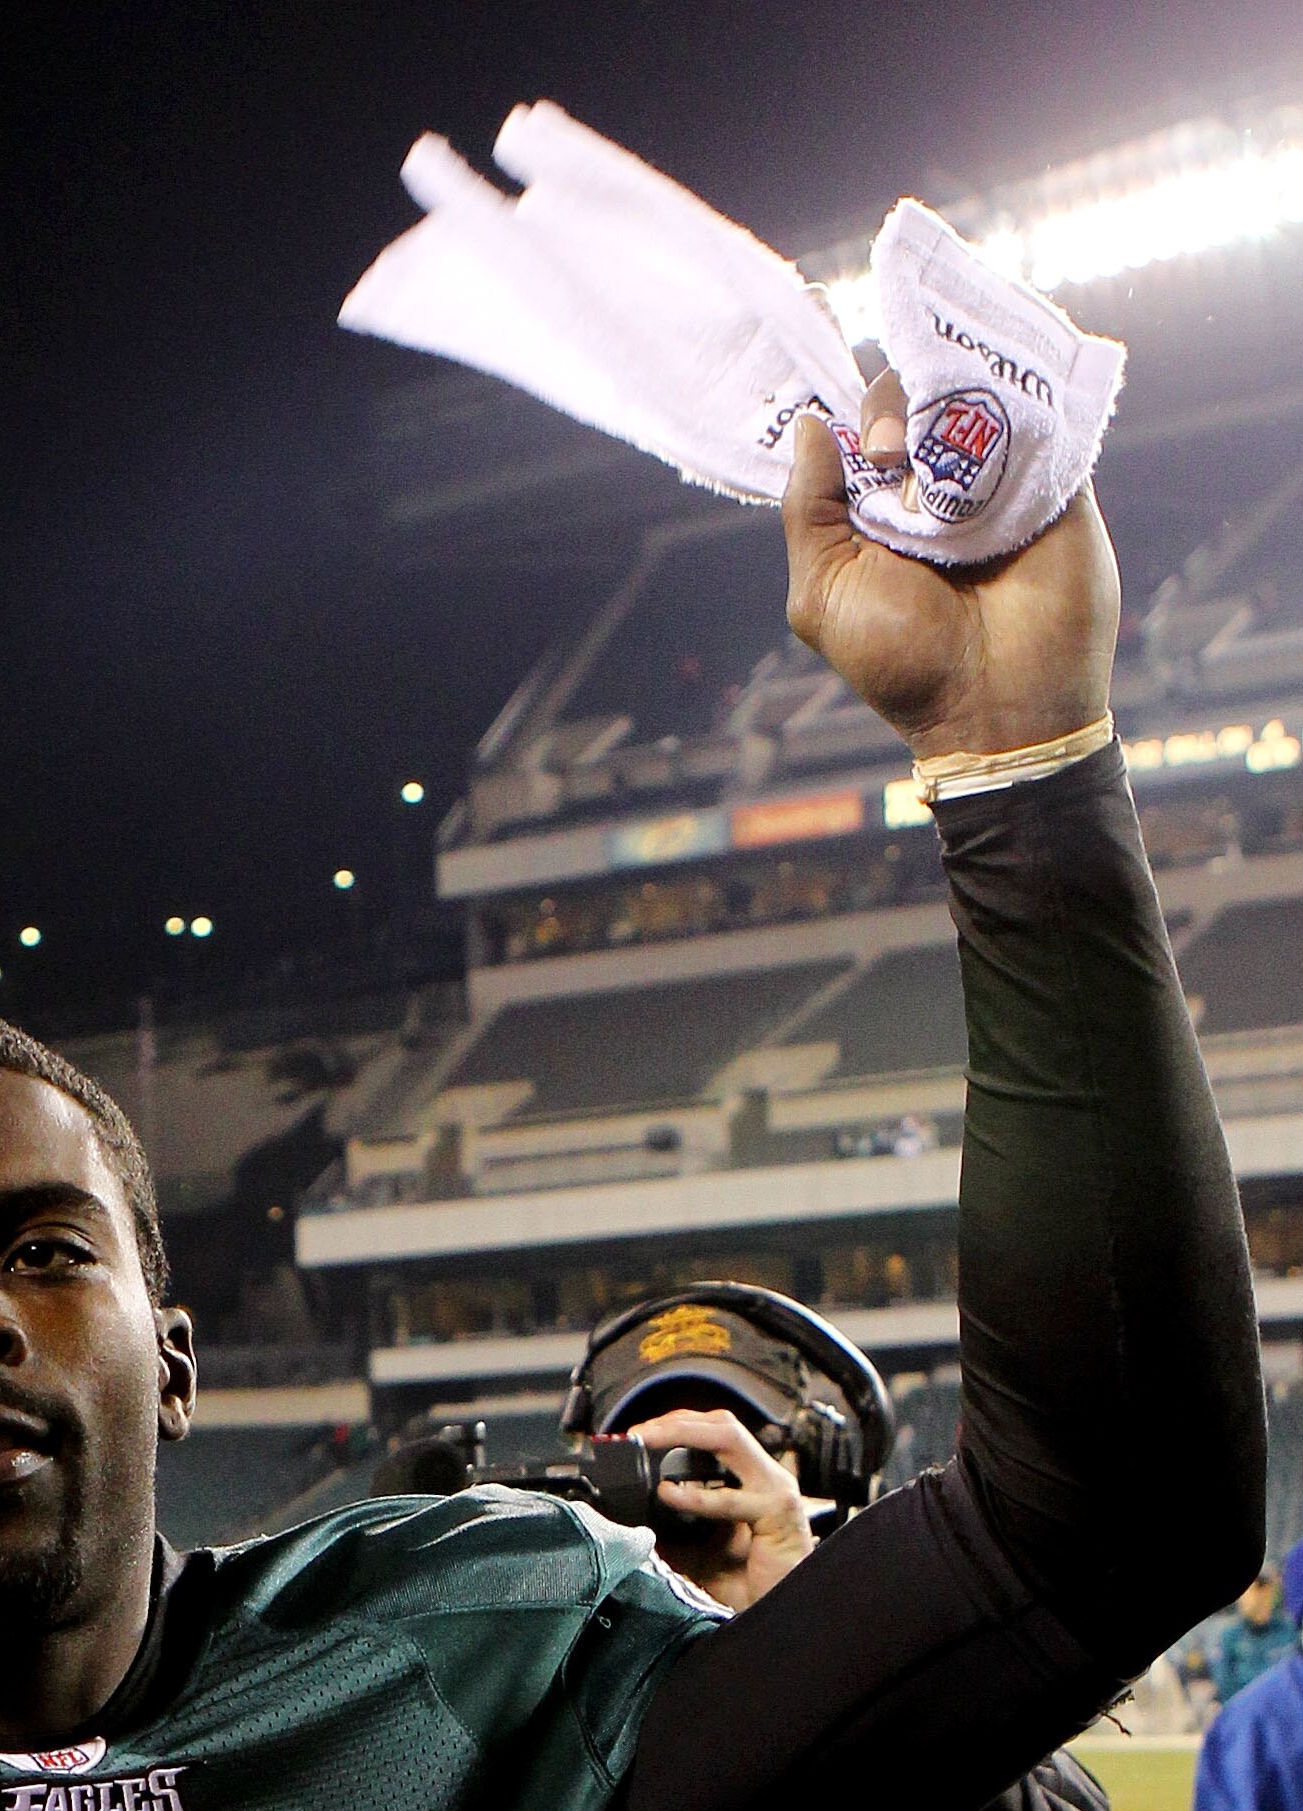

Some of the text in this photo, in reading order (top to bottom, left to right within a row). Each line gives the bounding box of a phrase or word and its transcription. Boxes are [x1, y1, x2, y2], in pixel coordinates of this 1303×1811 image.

[927, 308, 1053, 406] Wilson
[941, 404, 999, 459] NFL
[37, 1748, 83, 1769] NFL
